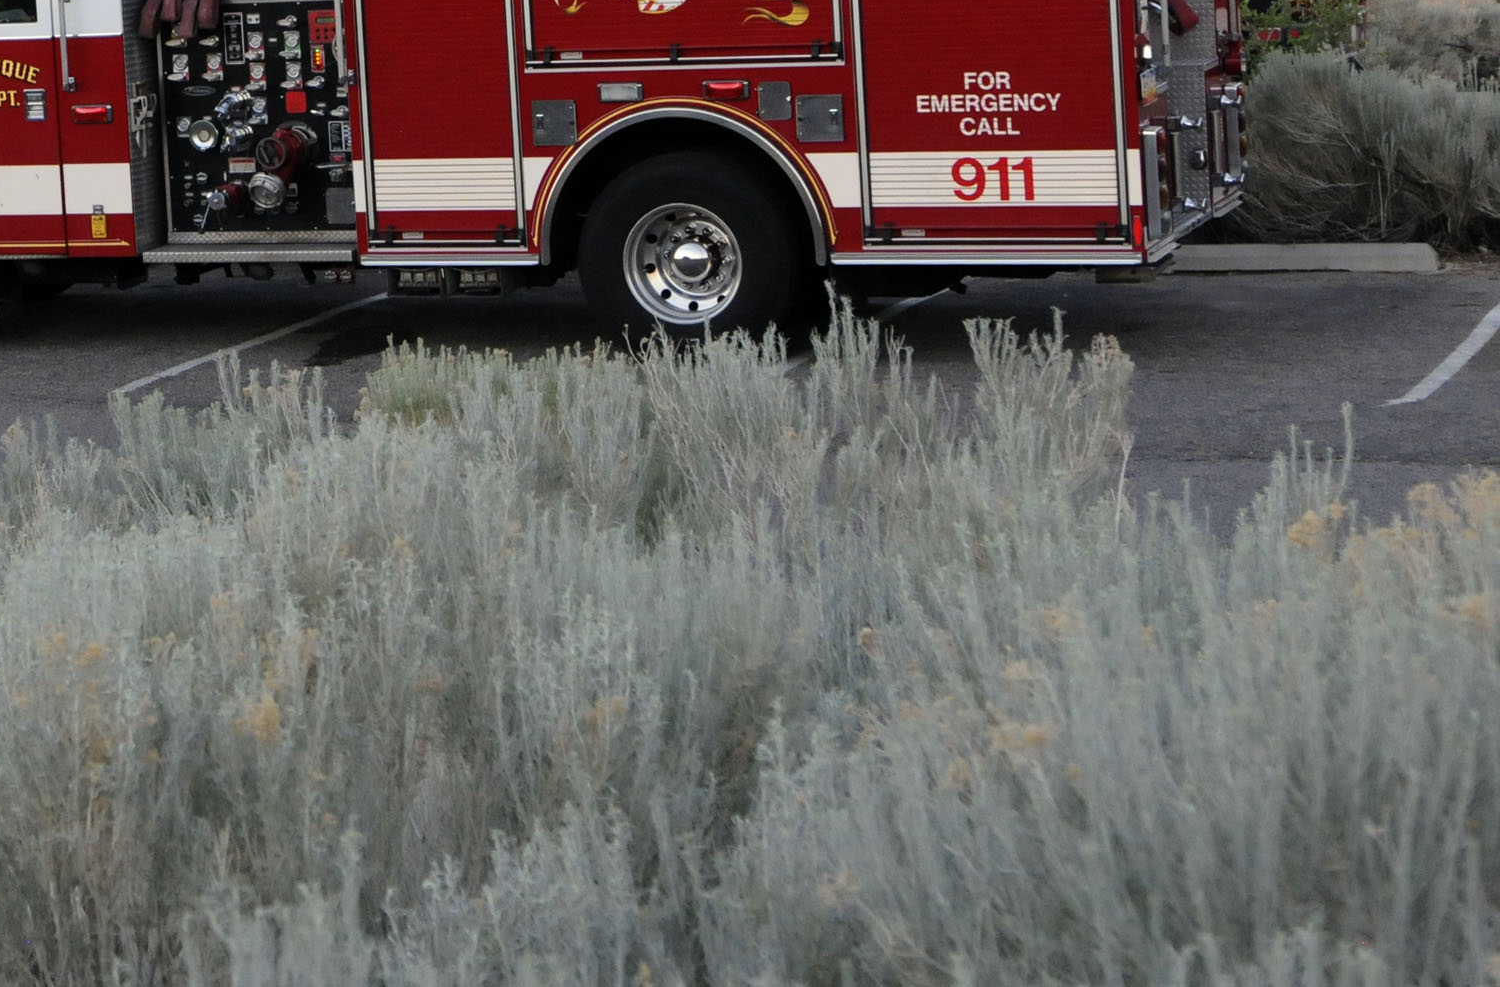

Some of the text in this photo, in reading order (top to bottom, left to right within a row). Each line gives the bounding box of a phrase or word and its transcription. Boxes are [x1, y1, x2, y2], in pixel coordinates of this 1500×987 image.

[964, 71, 1011, 90] FOR
[916, 93, 1061, 113] EMERGENCY
[959, 117, 1020, 136] CALL
[951, 156, 1035, 202] 911
